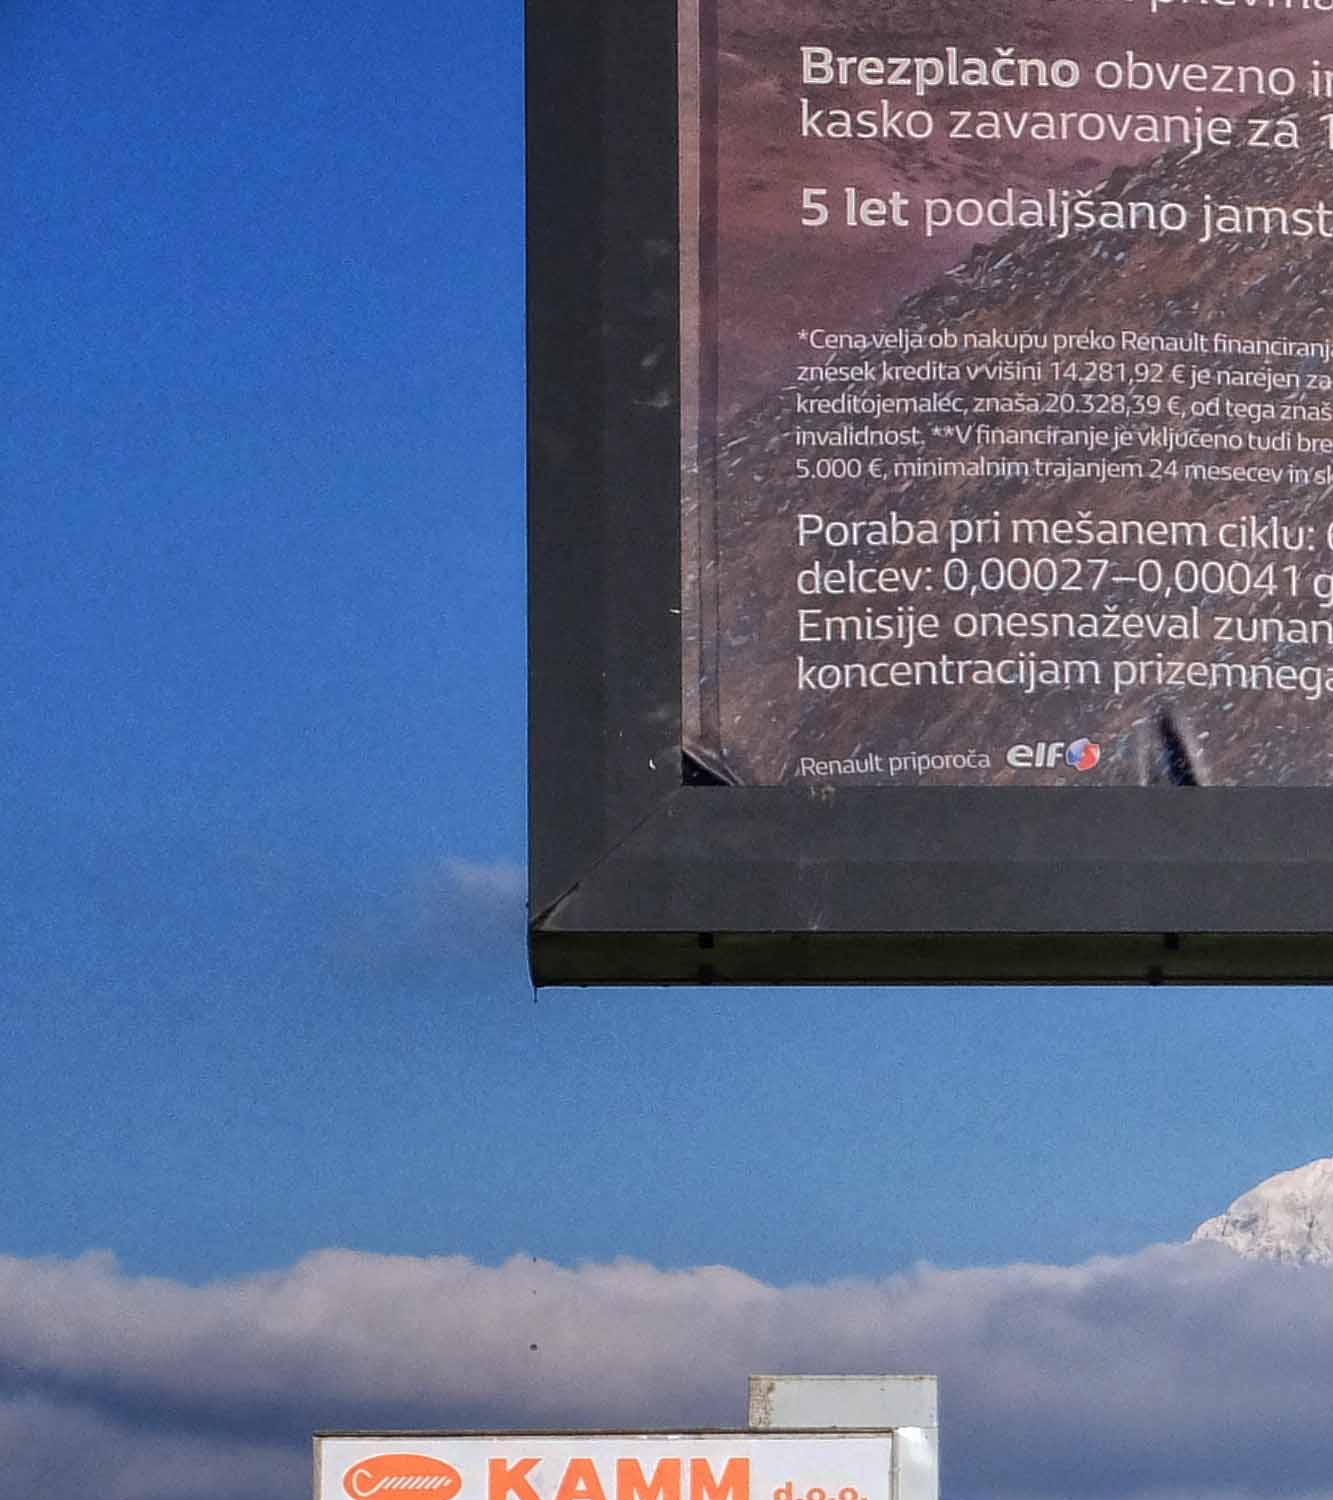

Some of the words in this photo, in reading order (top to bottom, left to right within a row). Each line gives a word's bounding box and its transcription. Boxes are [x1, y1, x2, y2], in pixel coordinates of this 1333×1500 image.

[801, 46, 1081, 96] Brezplačno
[1095, 51, 1296, 98] obvezno
[801, 99, 935, 142] kasko
[949, 108, 1232, 151] zavarovanje
[1247, 118, 1299, 150] za
[801, 188, 828, 227] 5
[844, 187, 909, 228] let
[922, 188, 1188, 238] podaljšano
[871, 329, 927, 353] velja
[928, 329, 959, 349] ob
[963, 329, 1048, 353] nakupu
[1053, 330, 1117, 354] preko
[1121, 331, 1209, 353] Renault
[797, 513, 939, 545] Poraba
[948, 512, 1001, 551] pri
[1012, 512, 1209, 547] mešanem
[1218, 515, 1315, 552] ciklu:
[796, 561, 933, 593] delcev:
[798, 606, 940, 647] Emisije
[953, 605, 1200, 640] onesnaževal
[797, 652, 1102, 694] koncentracijam
[800, 753, 883, 778] Renault
[888, 748, 991, 777] priporoča
[1006, 741, 1065, 769] elf
